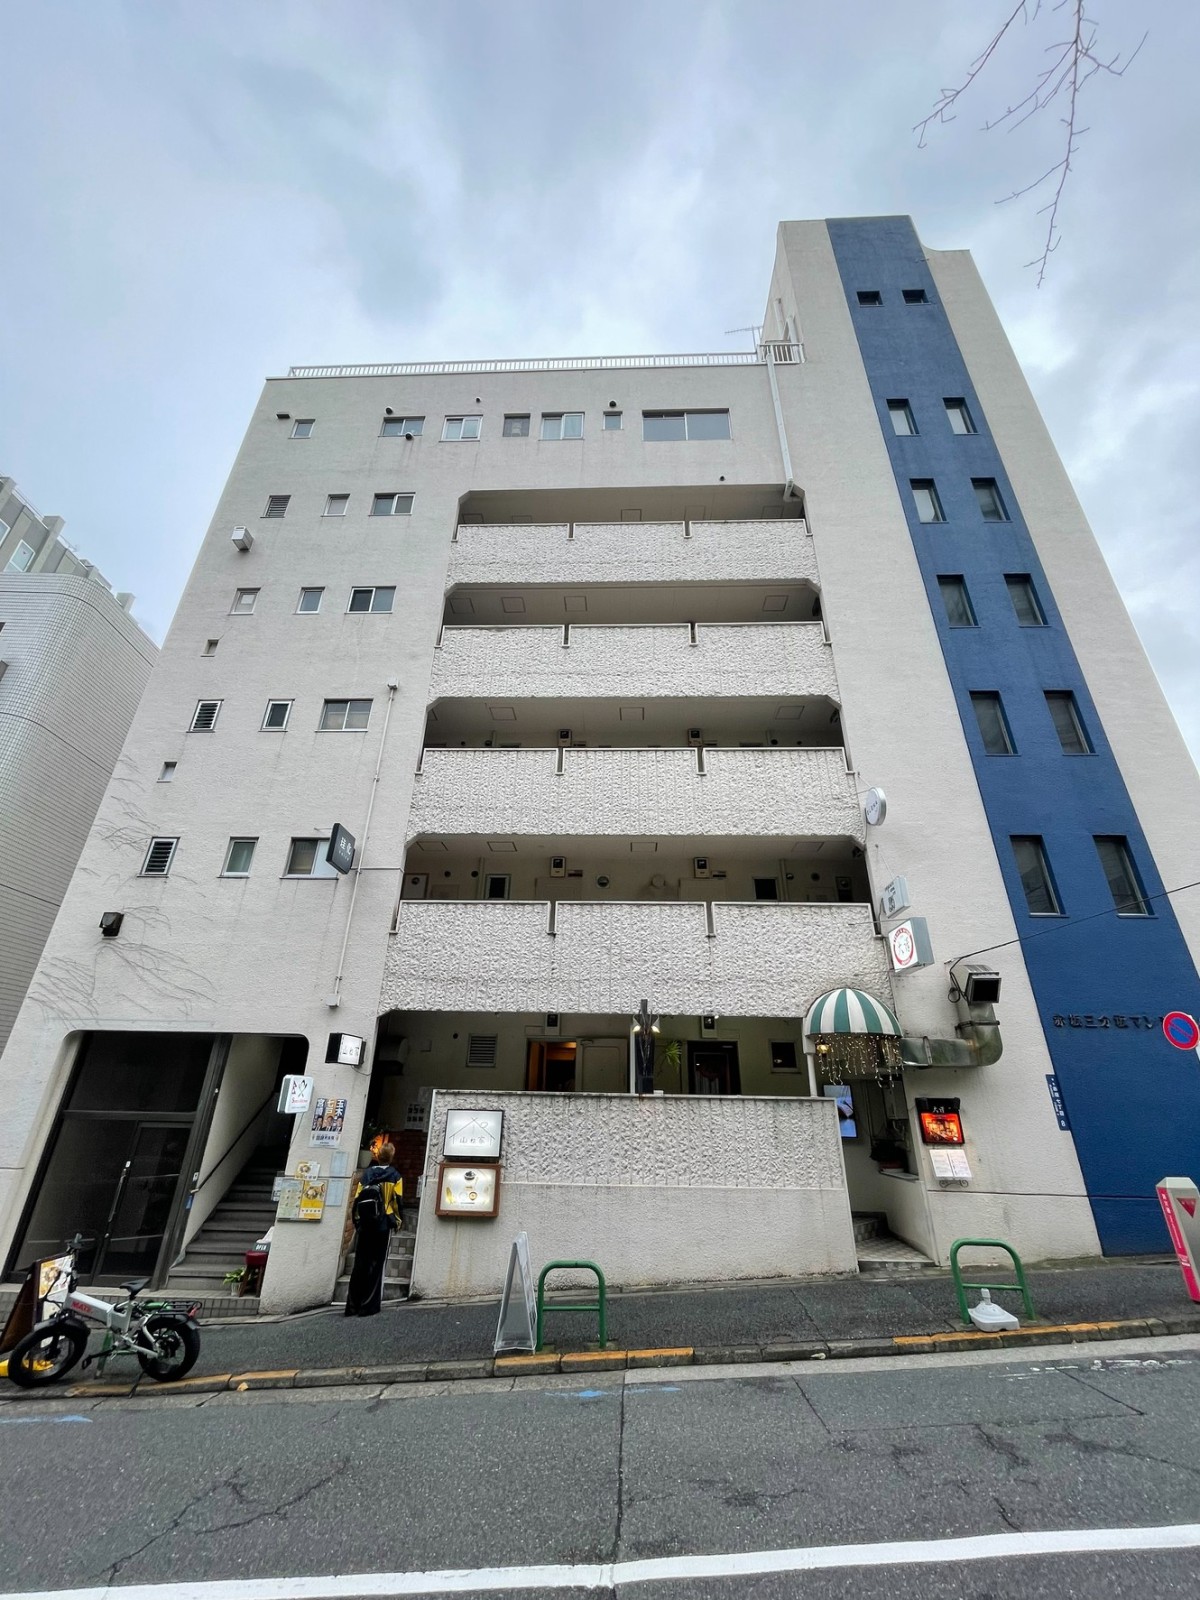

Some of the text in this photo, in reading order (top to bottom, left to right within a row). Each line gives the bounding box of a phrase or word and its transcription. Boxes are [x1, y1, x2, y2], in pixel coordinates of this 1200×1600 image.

[1053, 1013, 1164, 1029] 赤坂三分坂マン
